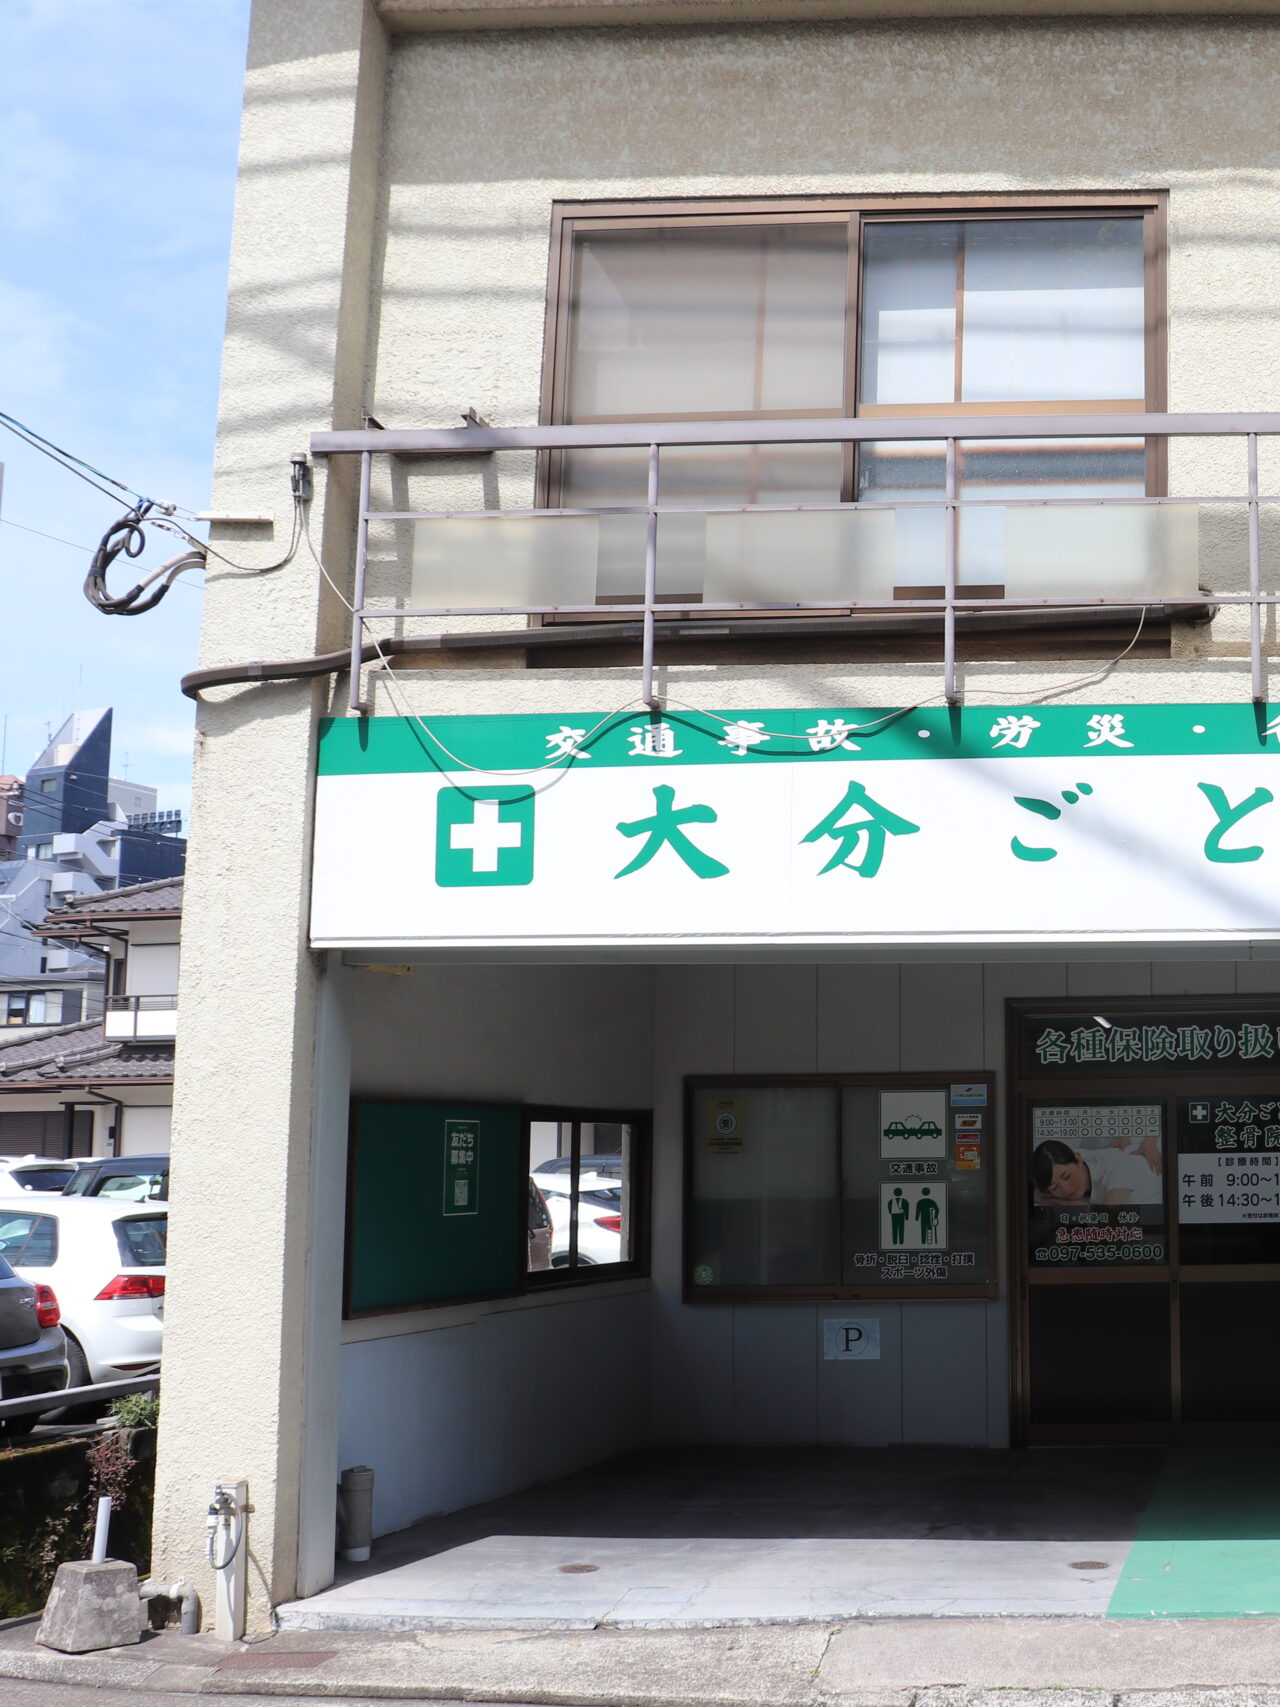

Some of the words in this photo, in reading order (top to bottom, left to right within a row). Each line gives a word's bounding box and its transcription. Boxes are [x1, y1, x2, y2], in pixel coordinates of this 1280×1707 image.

[890, 1161, 938, 1175] 交通事故
[1182, 1173, 1214, 1187] 午前
[1182, 1193, 1214, 1208] 午後
[1056, 1226, 1143, 1243] 急患随時対応
[1049, 1245, 1163, 1260] 097-535-0600
[881, 1266, 948, 1279] スポーツ外傷
[842, 1327, 863, 1352] P
